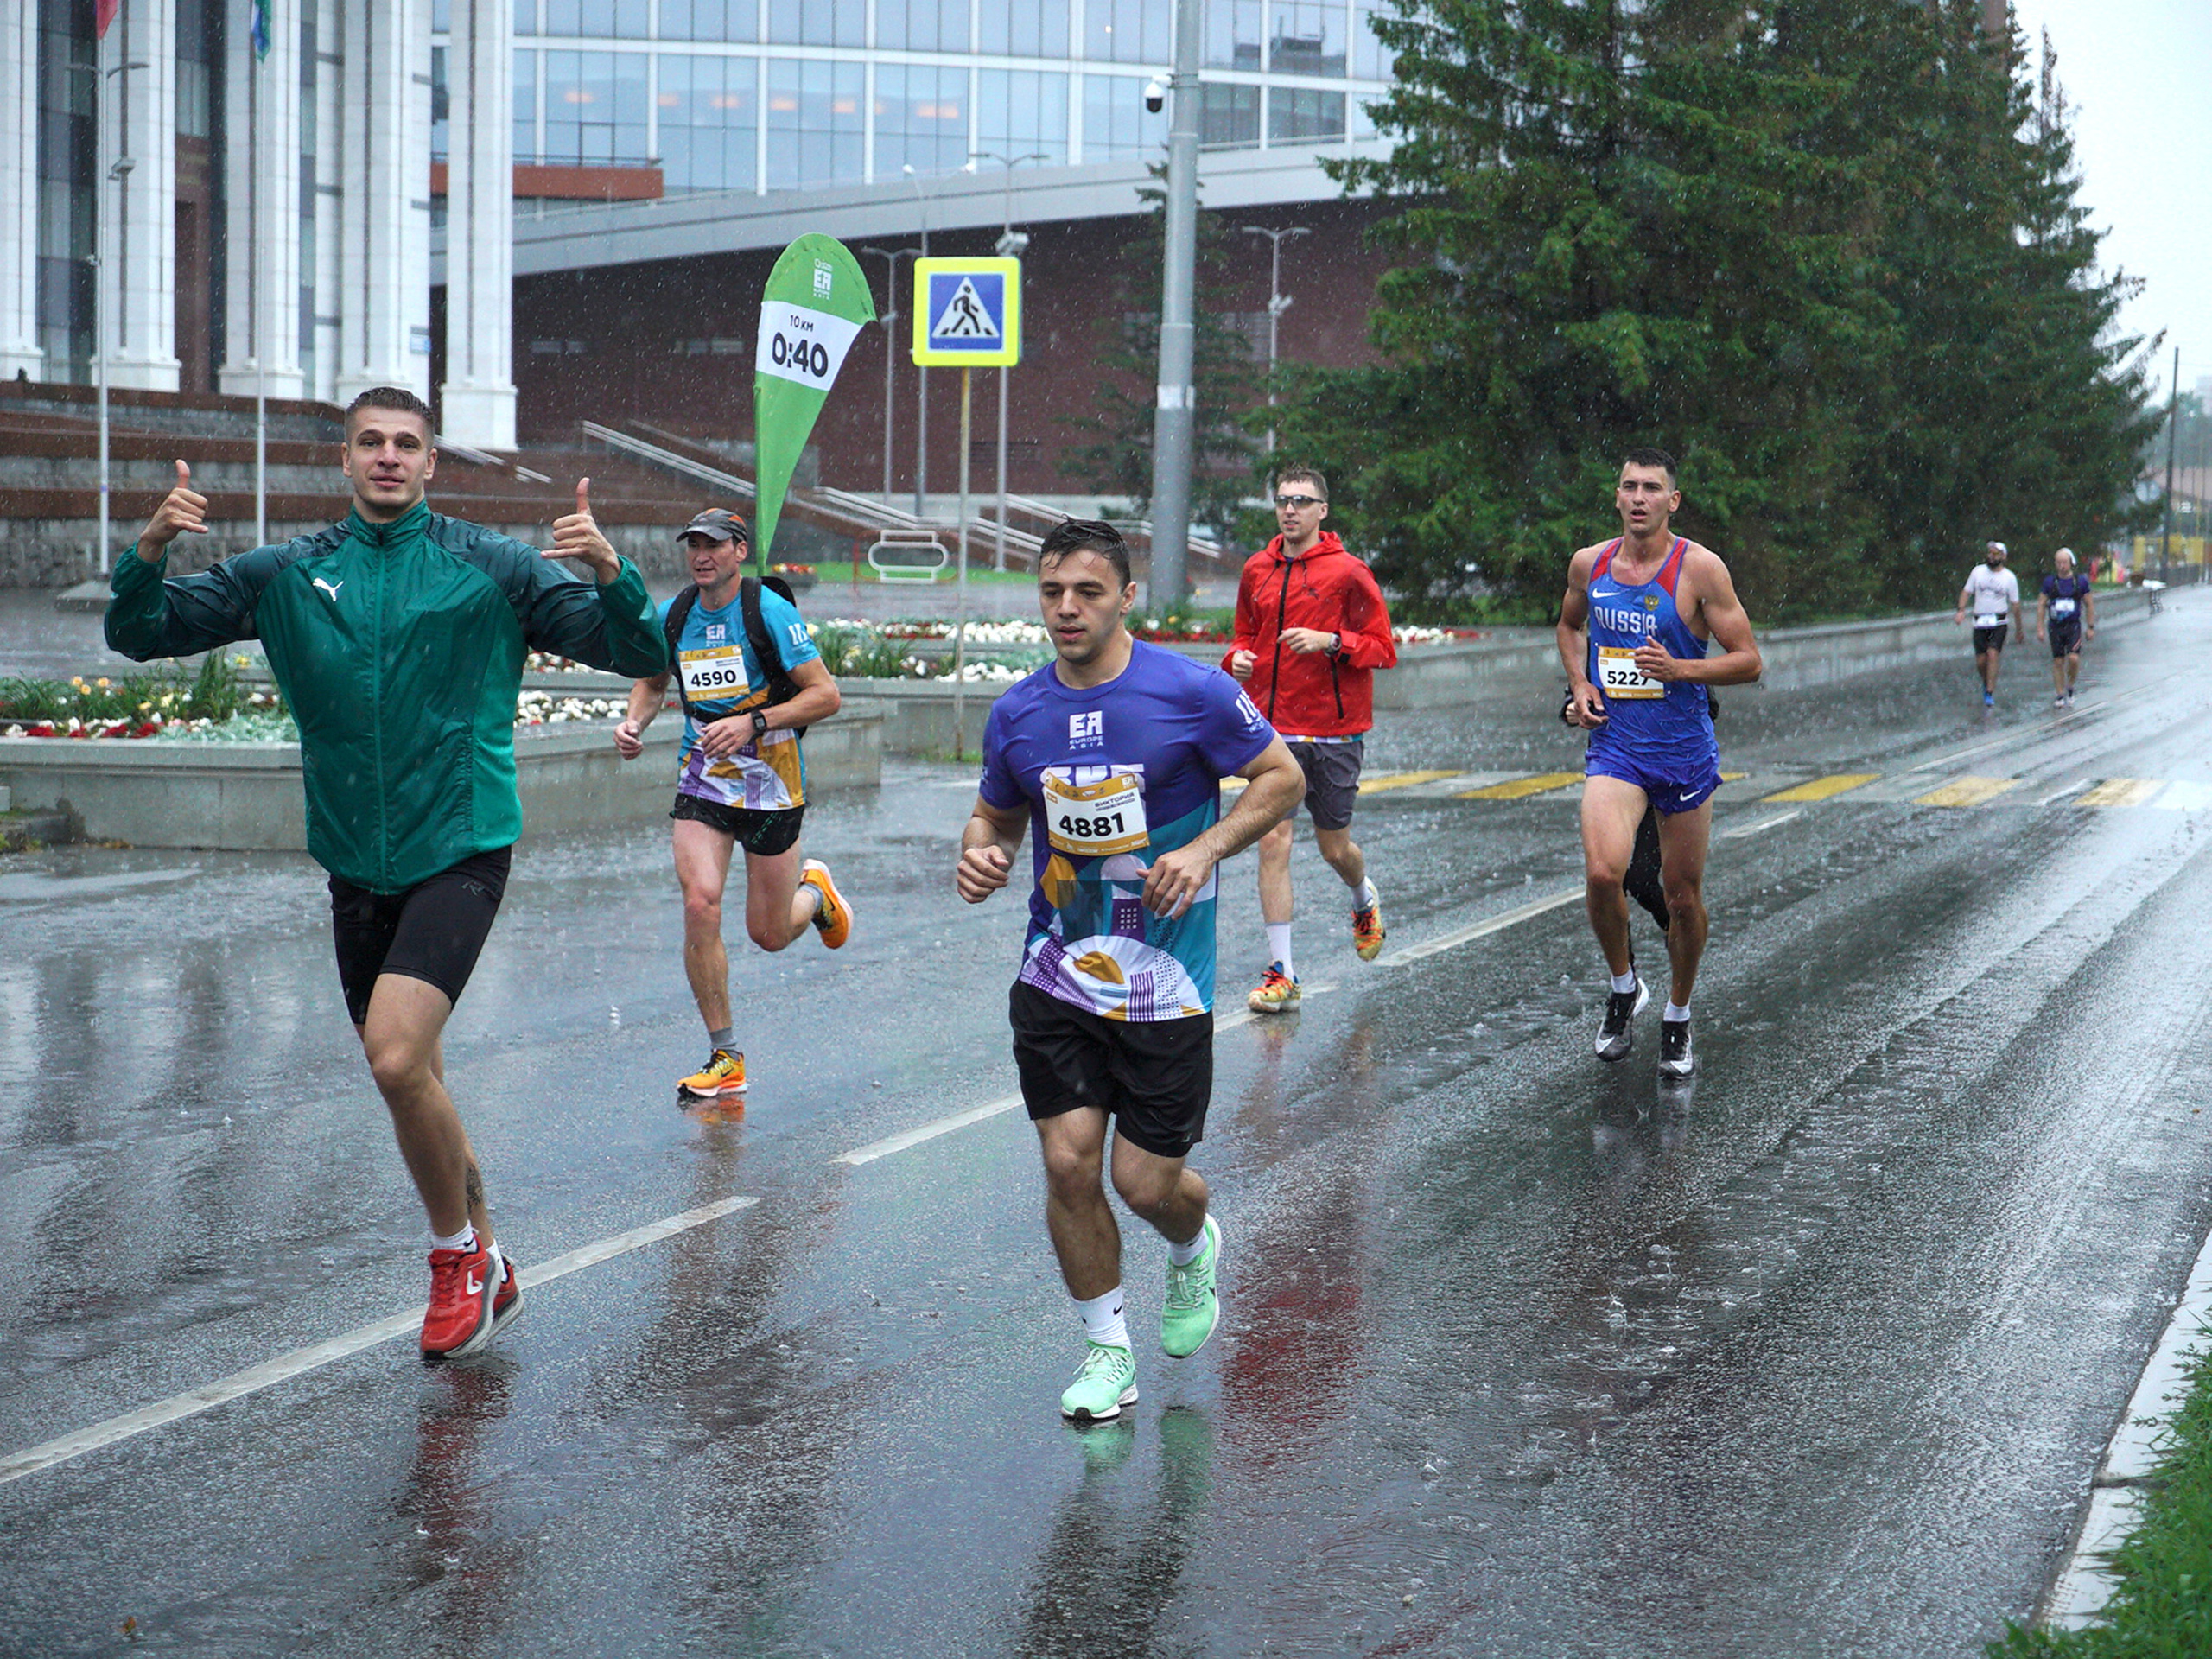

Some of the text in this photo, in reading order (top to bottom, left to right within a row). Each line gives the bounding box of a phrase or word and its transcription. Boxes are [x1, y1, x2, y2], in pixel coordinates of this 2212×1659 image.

[790, 315, 800, 327] 10
[772, 331, 829, 378] 0:40
[1594, 606, 1657, 636] RUSSIA
[690, 669, 737, 687] 4590
[1070, 710, 1103, 739] EA
[1069, 735, 1103, 745] EUROPE
[1059, 812, 1125, 838] 4881
